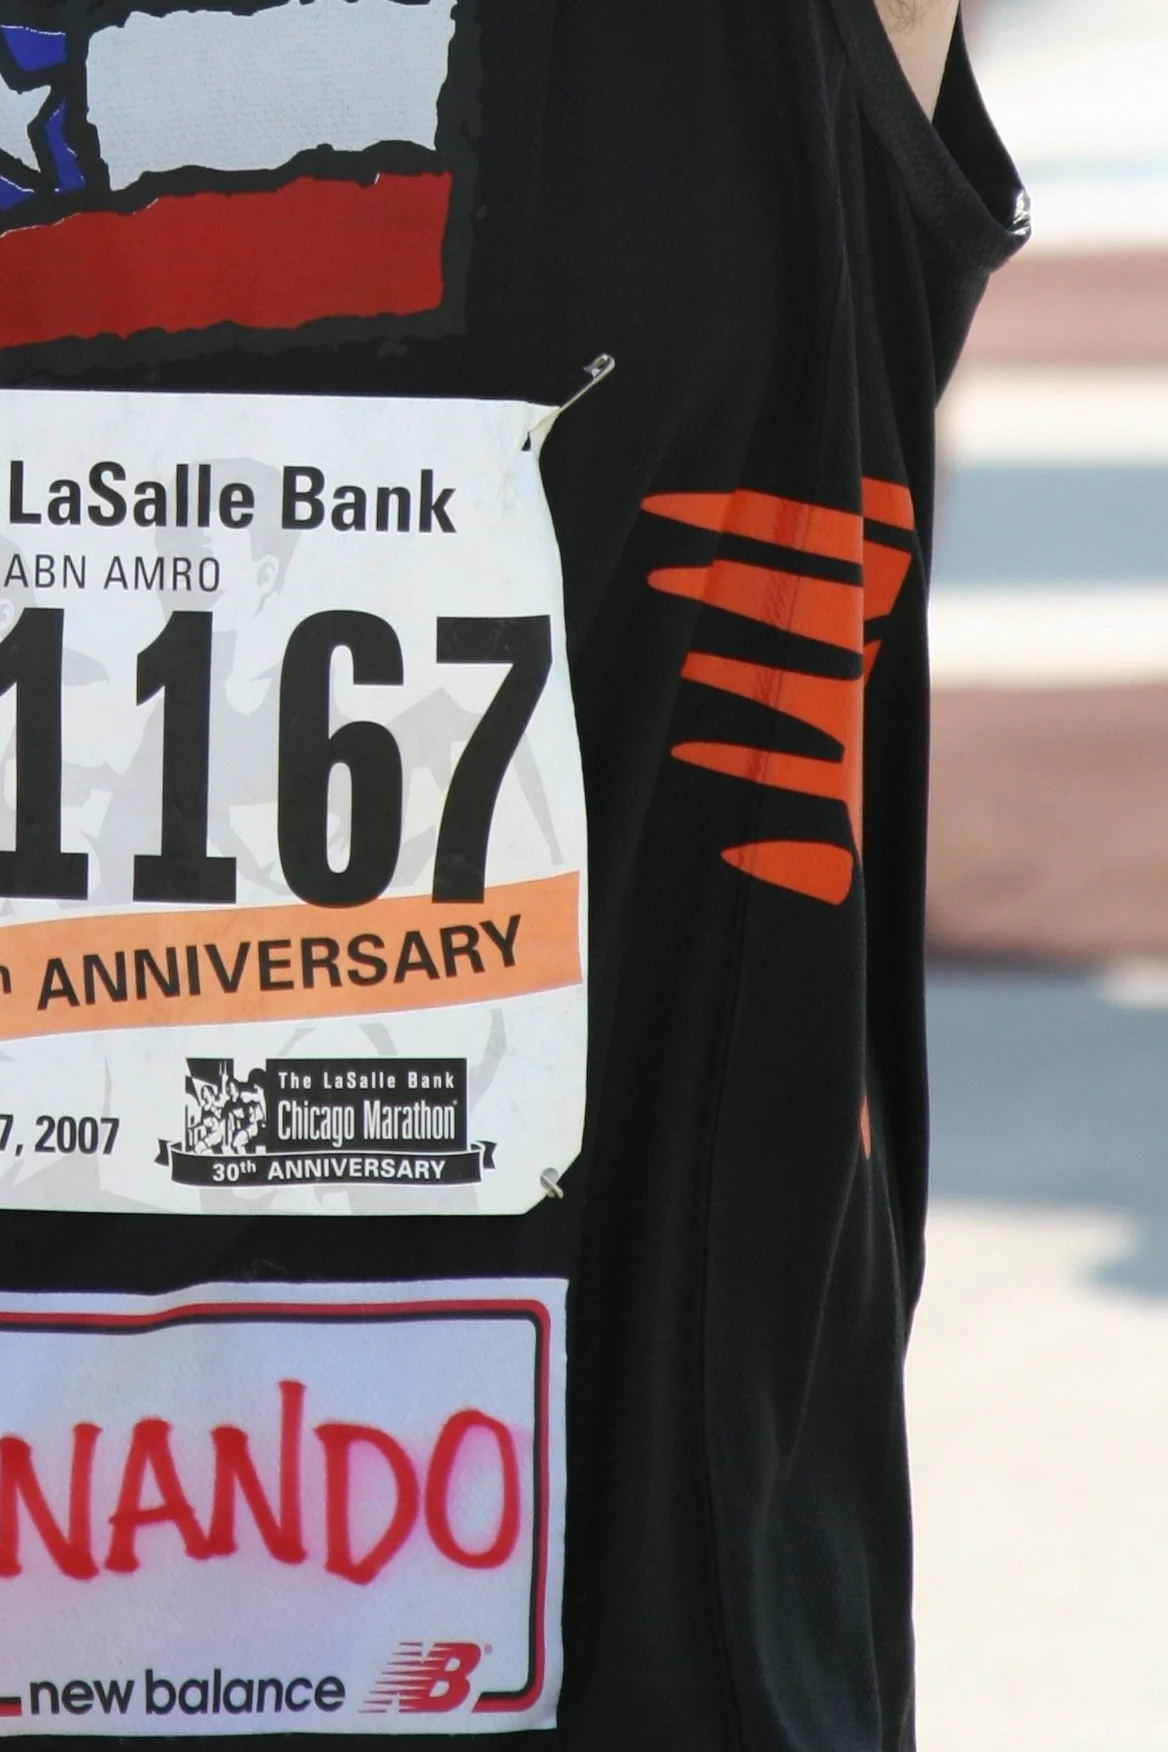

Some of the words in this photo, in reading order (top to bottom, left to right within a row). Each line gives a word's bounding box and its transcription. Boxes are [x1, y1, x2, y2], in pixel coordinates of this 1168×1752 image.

[8, 460, 255, 530] LaSalle
[281, 465, 458, 535] Bank
[3, 553, 88, 589] ABN
[102, 556, 221, 593] AMRO
[36, 914, 523, 1011] ANNIVERSARY
[278, 1071, 312, 1090] The
[323, 1071, 396, 1090] LaSalle
[408, 1071, 455, 1090] Bank
[34, 1115, 120, 1156] 2007
[277, 1099, 355, 1148] Chicago
[212, 1160, 257, 1182] 30th
[267, 1157, 446, 1181] ANNIVERSARY
[29, 1679, 136, 1715] new
[144, 1668, 346, 1715] balance
